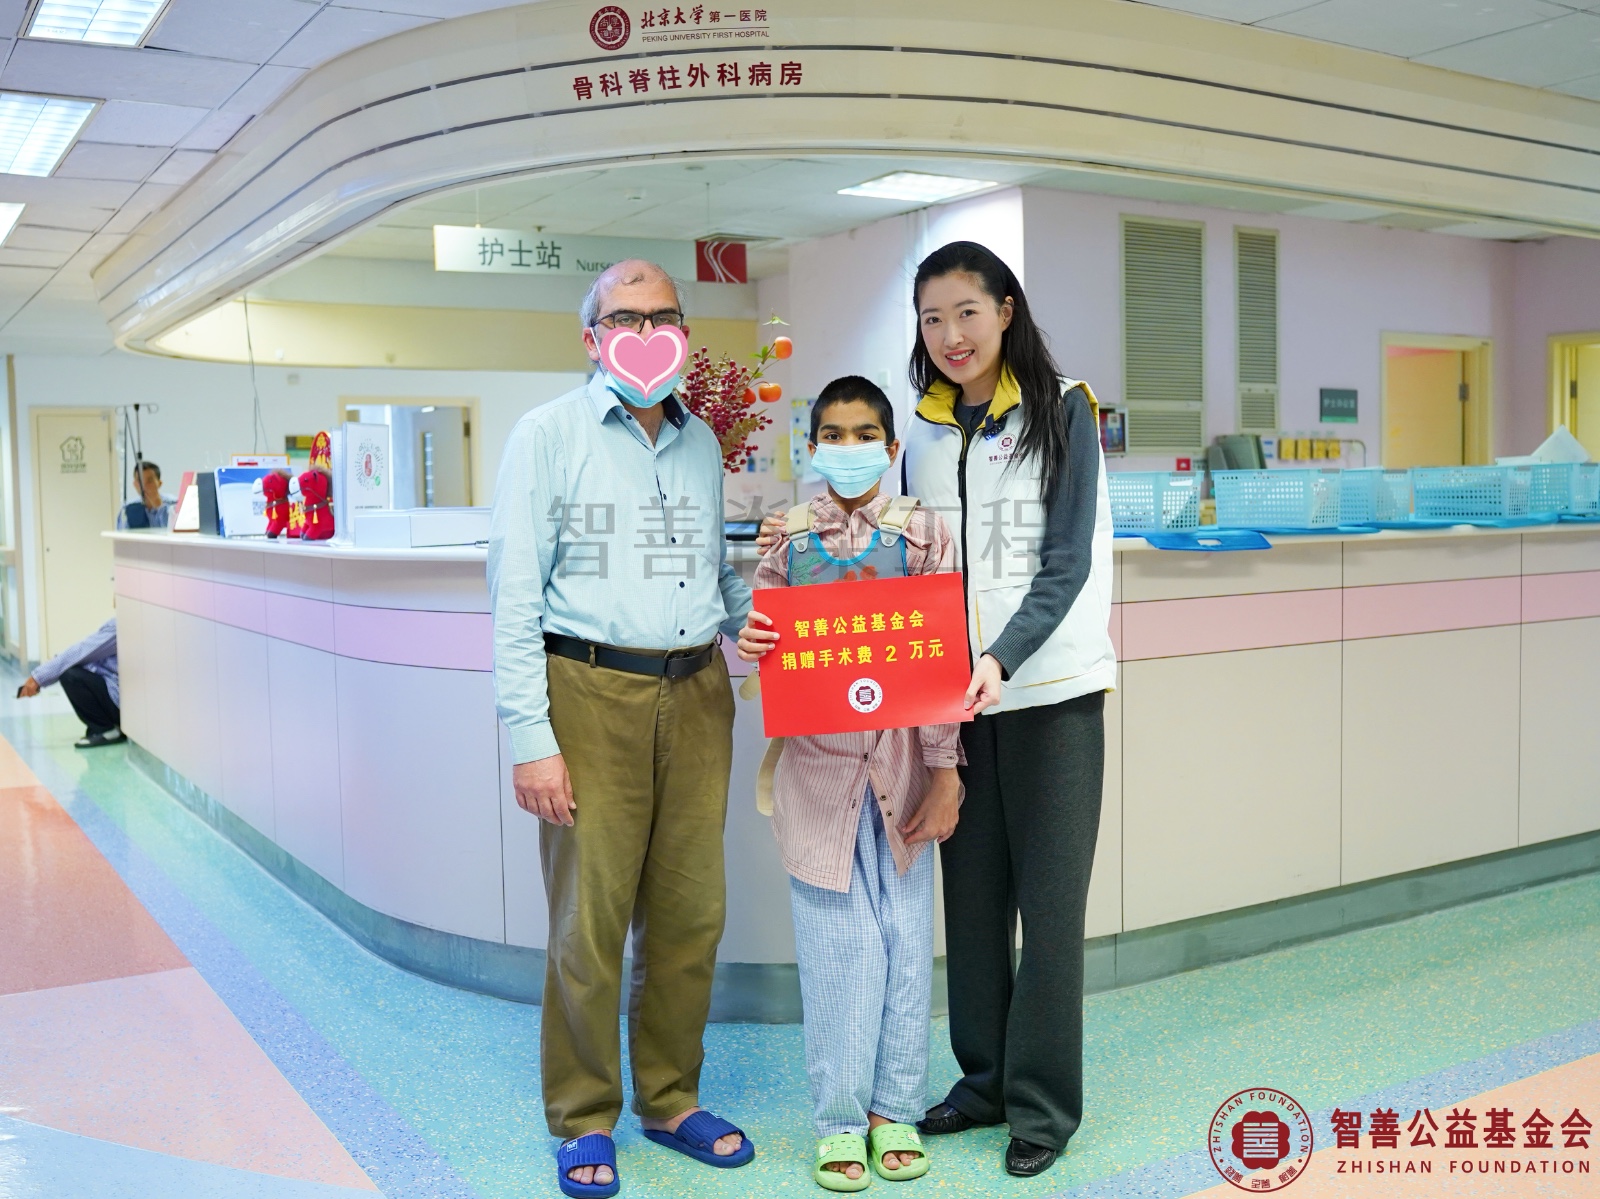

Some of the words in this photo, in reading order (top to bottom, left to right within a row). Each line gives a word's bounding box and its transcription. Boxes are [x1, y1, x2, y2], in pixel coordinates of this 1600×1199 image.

[640, 4, 768, 29] 北京大学第一医院
[670, 33, 711, 41] UNIVERSITY
[573, 61, 803, 100] 骨科脊柱外科病房
[478, 237, 562, 269] 护士站
[795, 610, 924, 638] 智善公益基金会
[782, 646, 872, 671] 捐赠手术费
[885, 646, 897, 662] 2
[909, 639, 943, 659] 万元
